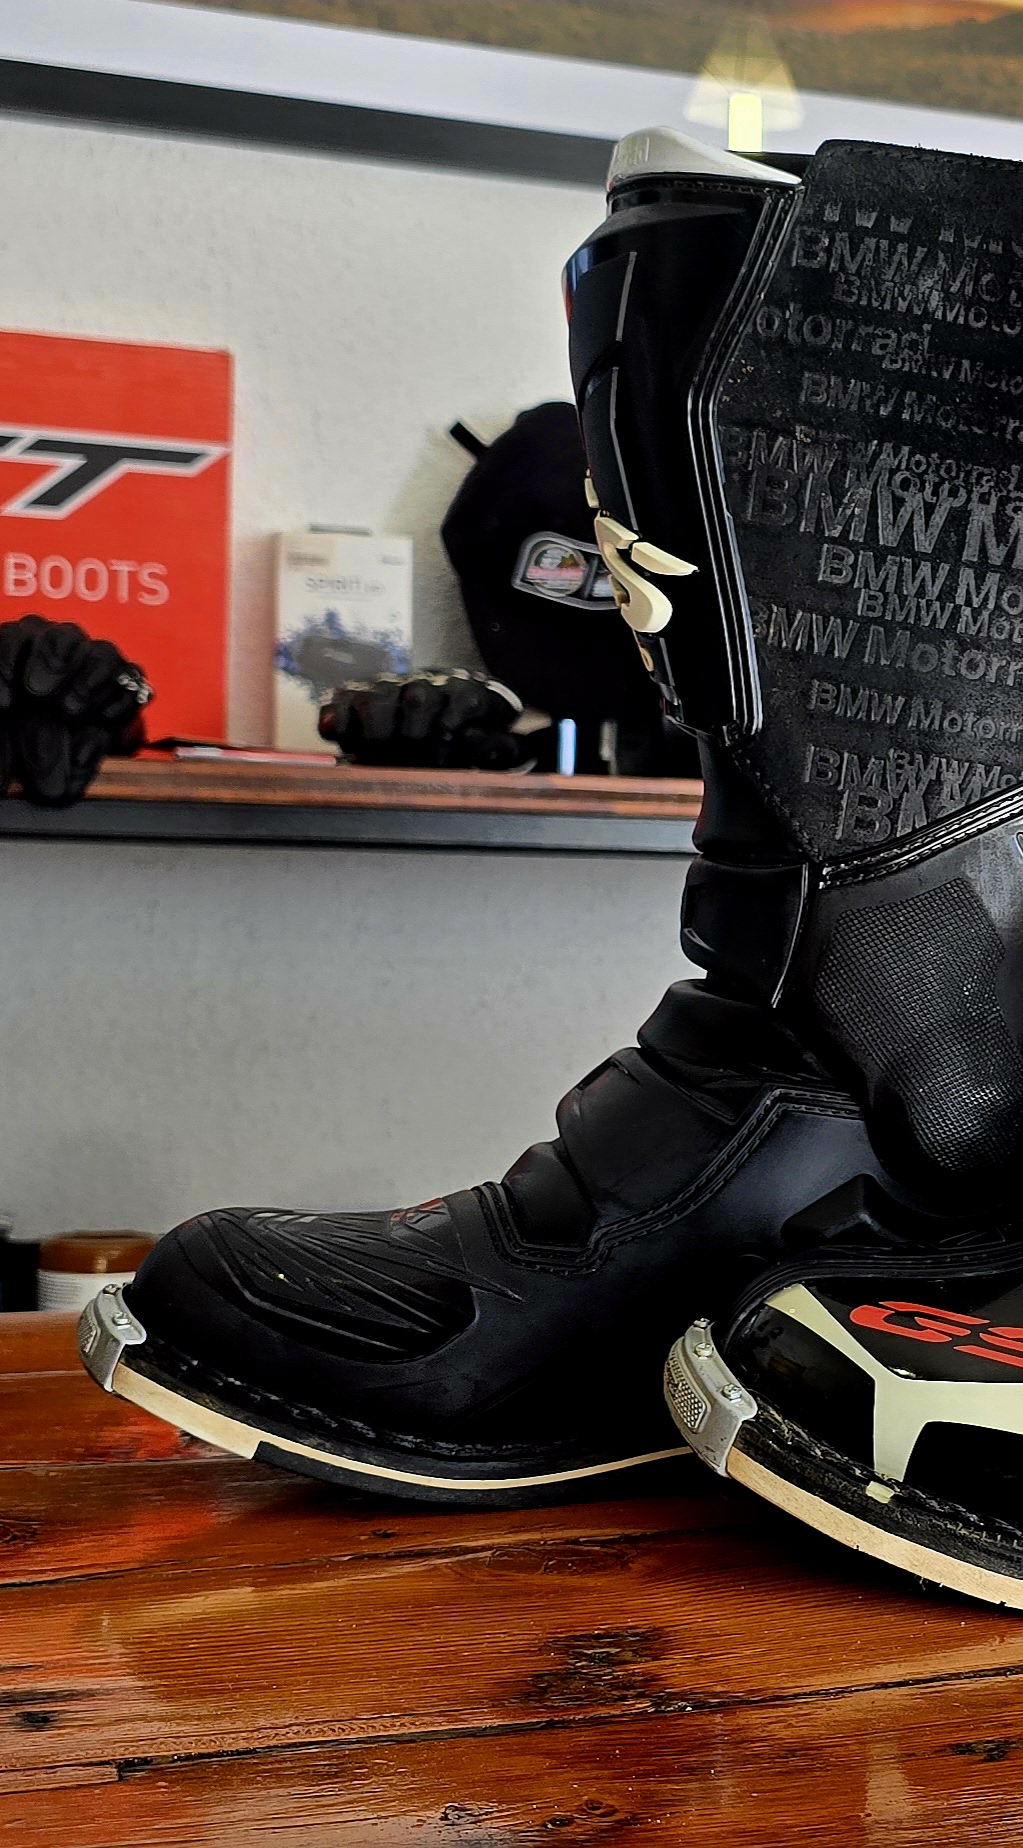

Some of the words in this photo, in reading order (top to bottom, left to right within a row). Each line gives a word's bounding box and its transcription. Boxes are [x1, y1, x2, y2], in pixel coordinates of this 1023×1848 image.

[801, 370, 901, 416] BMW
[3, 551, 171, 607] BOOTS
[817, 543, 951, 600] BMW
[856, 587, 955, 630] BMW
[806, 678, 906, 725] BMW
